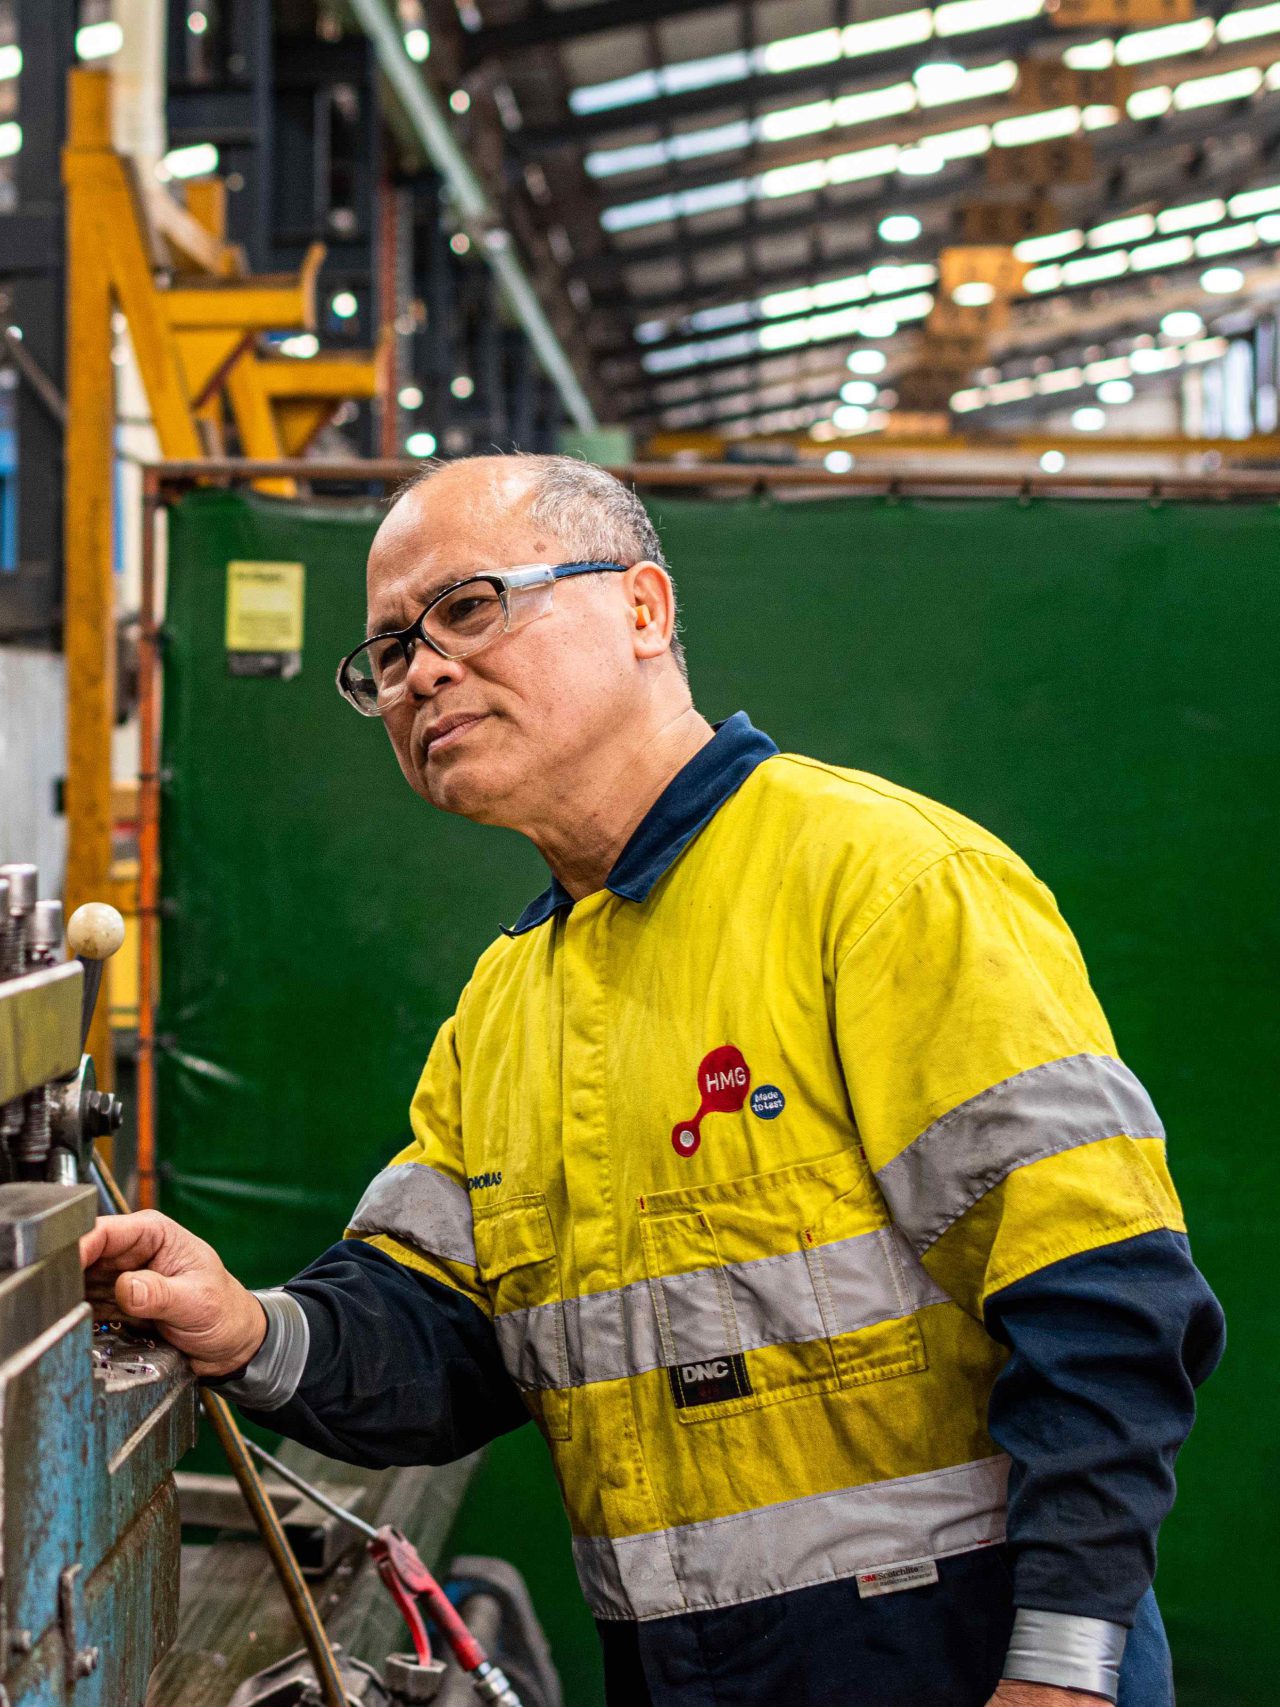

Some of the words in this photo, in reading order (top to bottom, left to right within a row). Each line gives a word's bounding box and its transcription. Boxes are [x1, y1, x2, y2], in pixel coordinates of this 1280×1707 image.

[706, 1067, 747, 1093] HMG
[754, 1091, 779, 1102] Made
[682, 1361, 729, 1383] DNC
[861, 1573, 877, 1583] 3M
